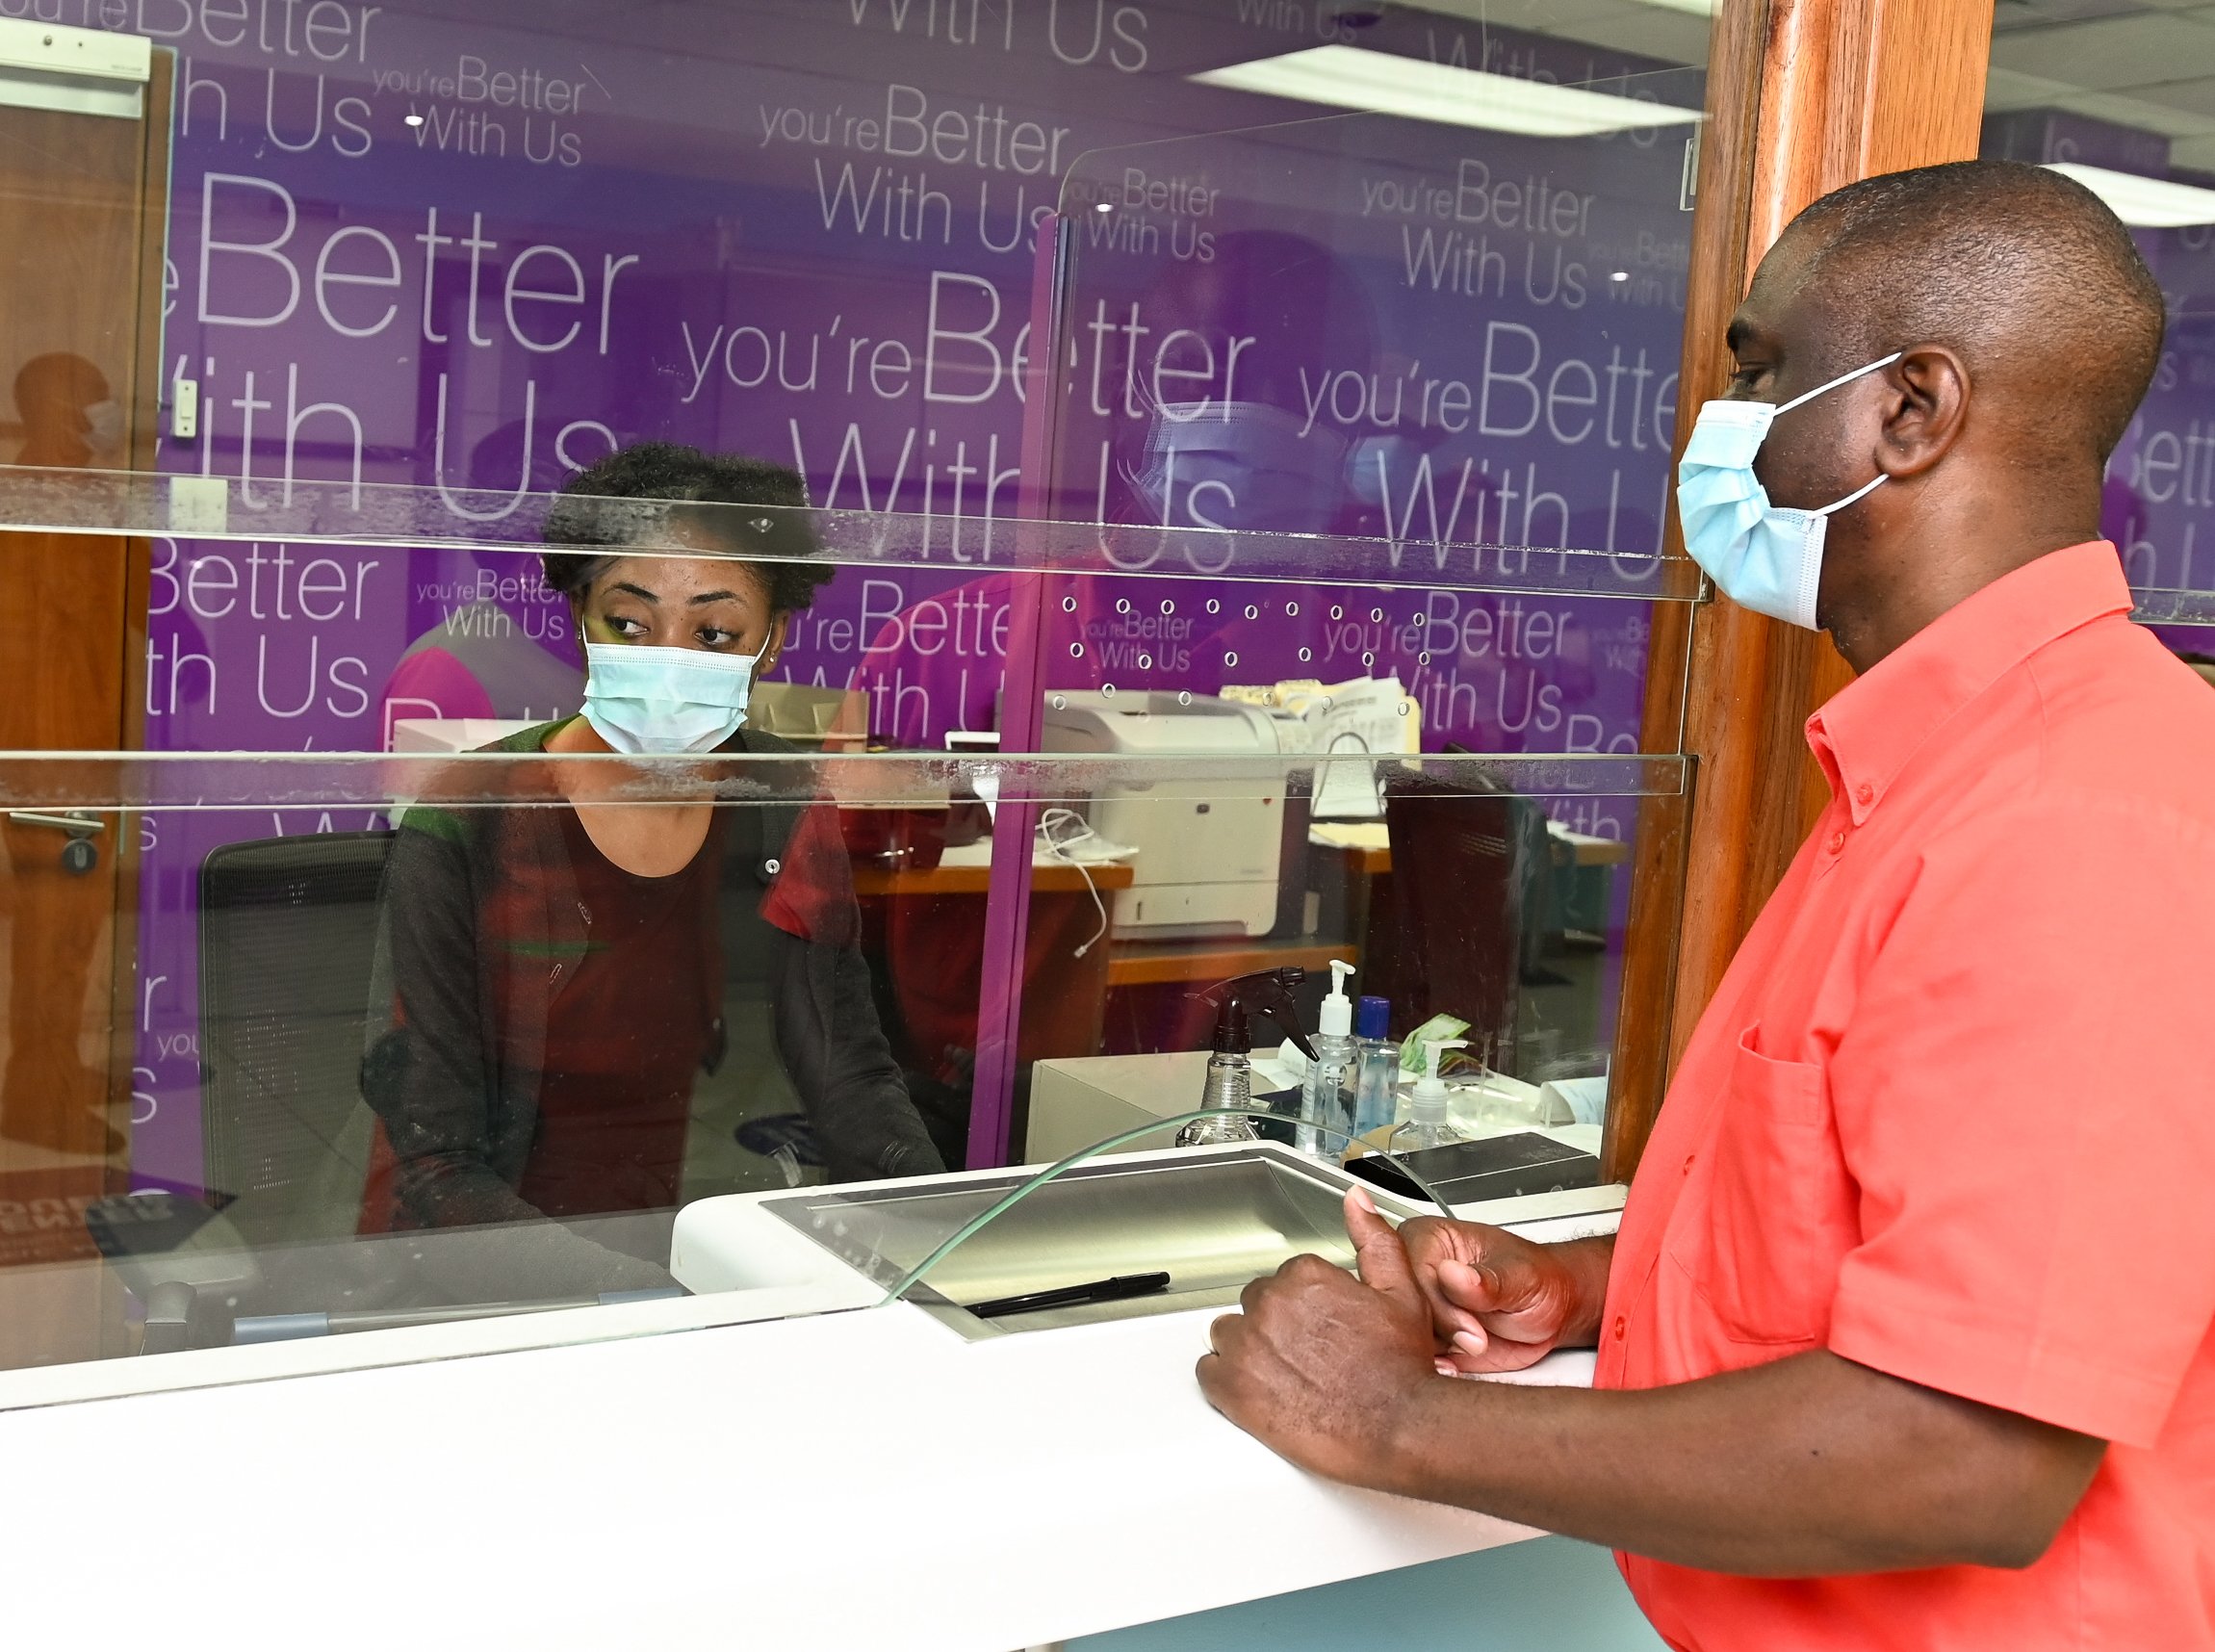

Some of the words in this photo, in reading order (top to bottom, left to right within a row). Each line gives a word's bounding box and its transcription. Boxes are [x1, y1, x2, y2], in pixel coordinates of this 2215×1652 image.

[1047, 0, 1148, 73] Us
[266, 66, 373, 157] Us
[410, 101, 505, 159] With
[521, 118, 582, 168] Us
[815, 157, 952, 245] With
[978, 181, 1055, 254] Us
[1086, 209, 1160, 256] With
[1172, 219, 1216, 265] Us
[197, 171, 640, 354] Better
[1403, 224, 1507, 298] With
[1524, 241, 1589, 311] Us
[1479, 321, 1680, 453] Bette
[157, 354, 364, 511] ith
[788, 418, 1021, 562] With
[1096, 439, 1238, 575] Us
[1376, 449, 1569, 577] With
[442, 604, 511, 639] With
[523, 607, 565, 641] Us
[1157, 641, 1192, 673] Us
[256, 633, 371, 718] Us
[1496, 667, 1563, 734] Us
